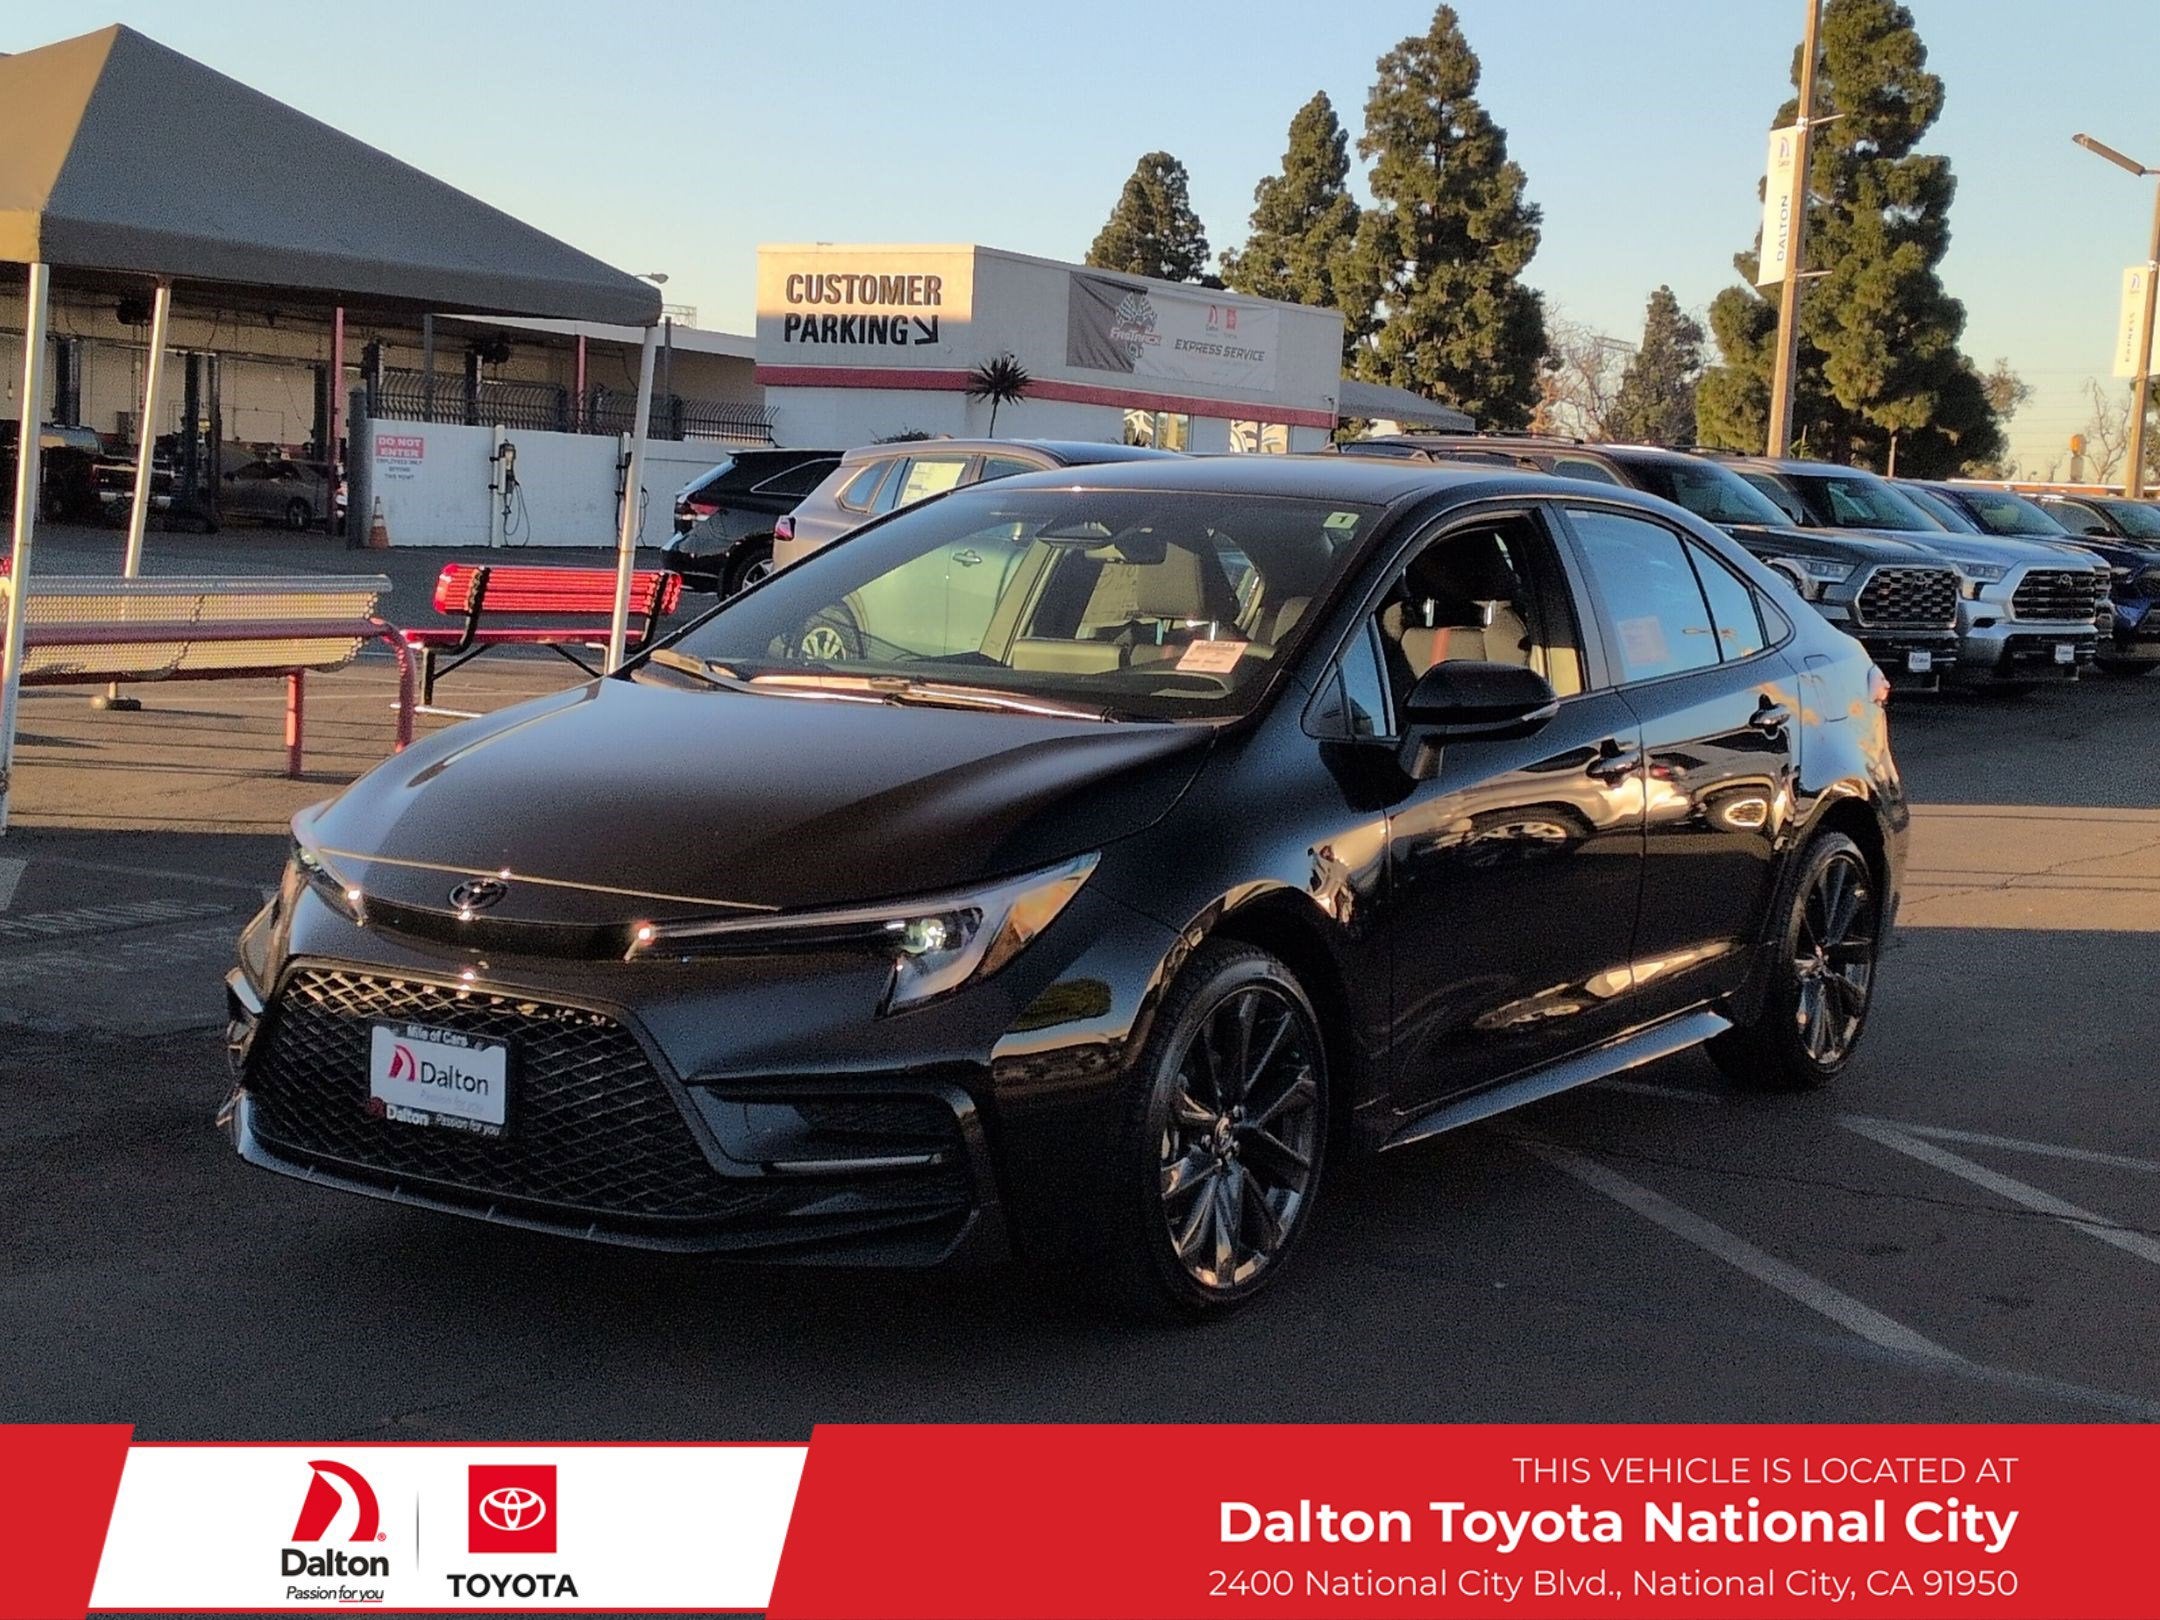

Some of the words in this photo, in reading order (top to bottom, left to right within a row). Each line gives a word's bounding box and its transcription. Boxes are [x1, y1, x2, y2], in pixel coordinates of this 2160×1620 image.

[1776, 195, 1789, 261] DALTON
[786, 273, 942, 306] CUSTOMER
[784, 312, 909, 346] PARKING
[1174, 338, 1223, 356] EXPRESS
[1223, 346, 1265, 362] SERVICE
[378, 437, 395, 446] DO
[397, 438, 422, 447] NOT
[380, 447, 419, 458] ENTER
[406, 1025, 429, 1040] Mile
[430, 1030, 441, 1042] of
[442, 1031, 468, 1047] Cars
[420, 1061, 489, 1096] Dalton
[386, 1103, 430, 1127] Dalton
[435, 1113, 469, 1130] Passion
[469, 1120, 482, 1132] for
[481, 1124, 501, 1137] you
